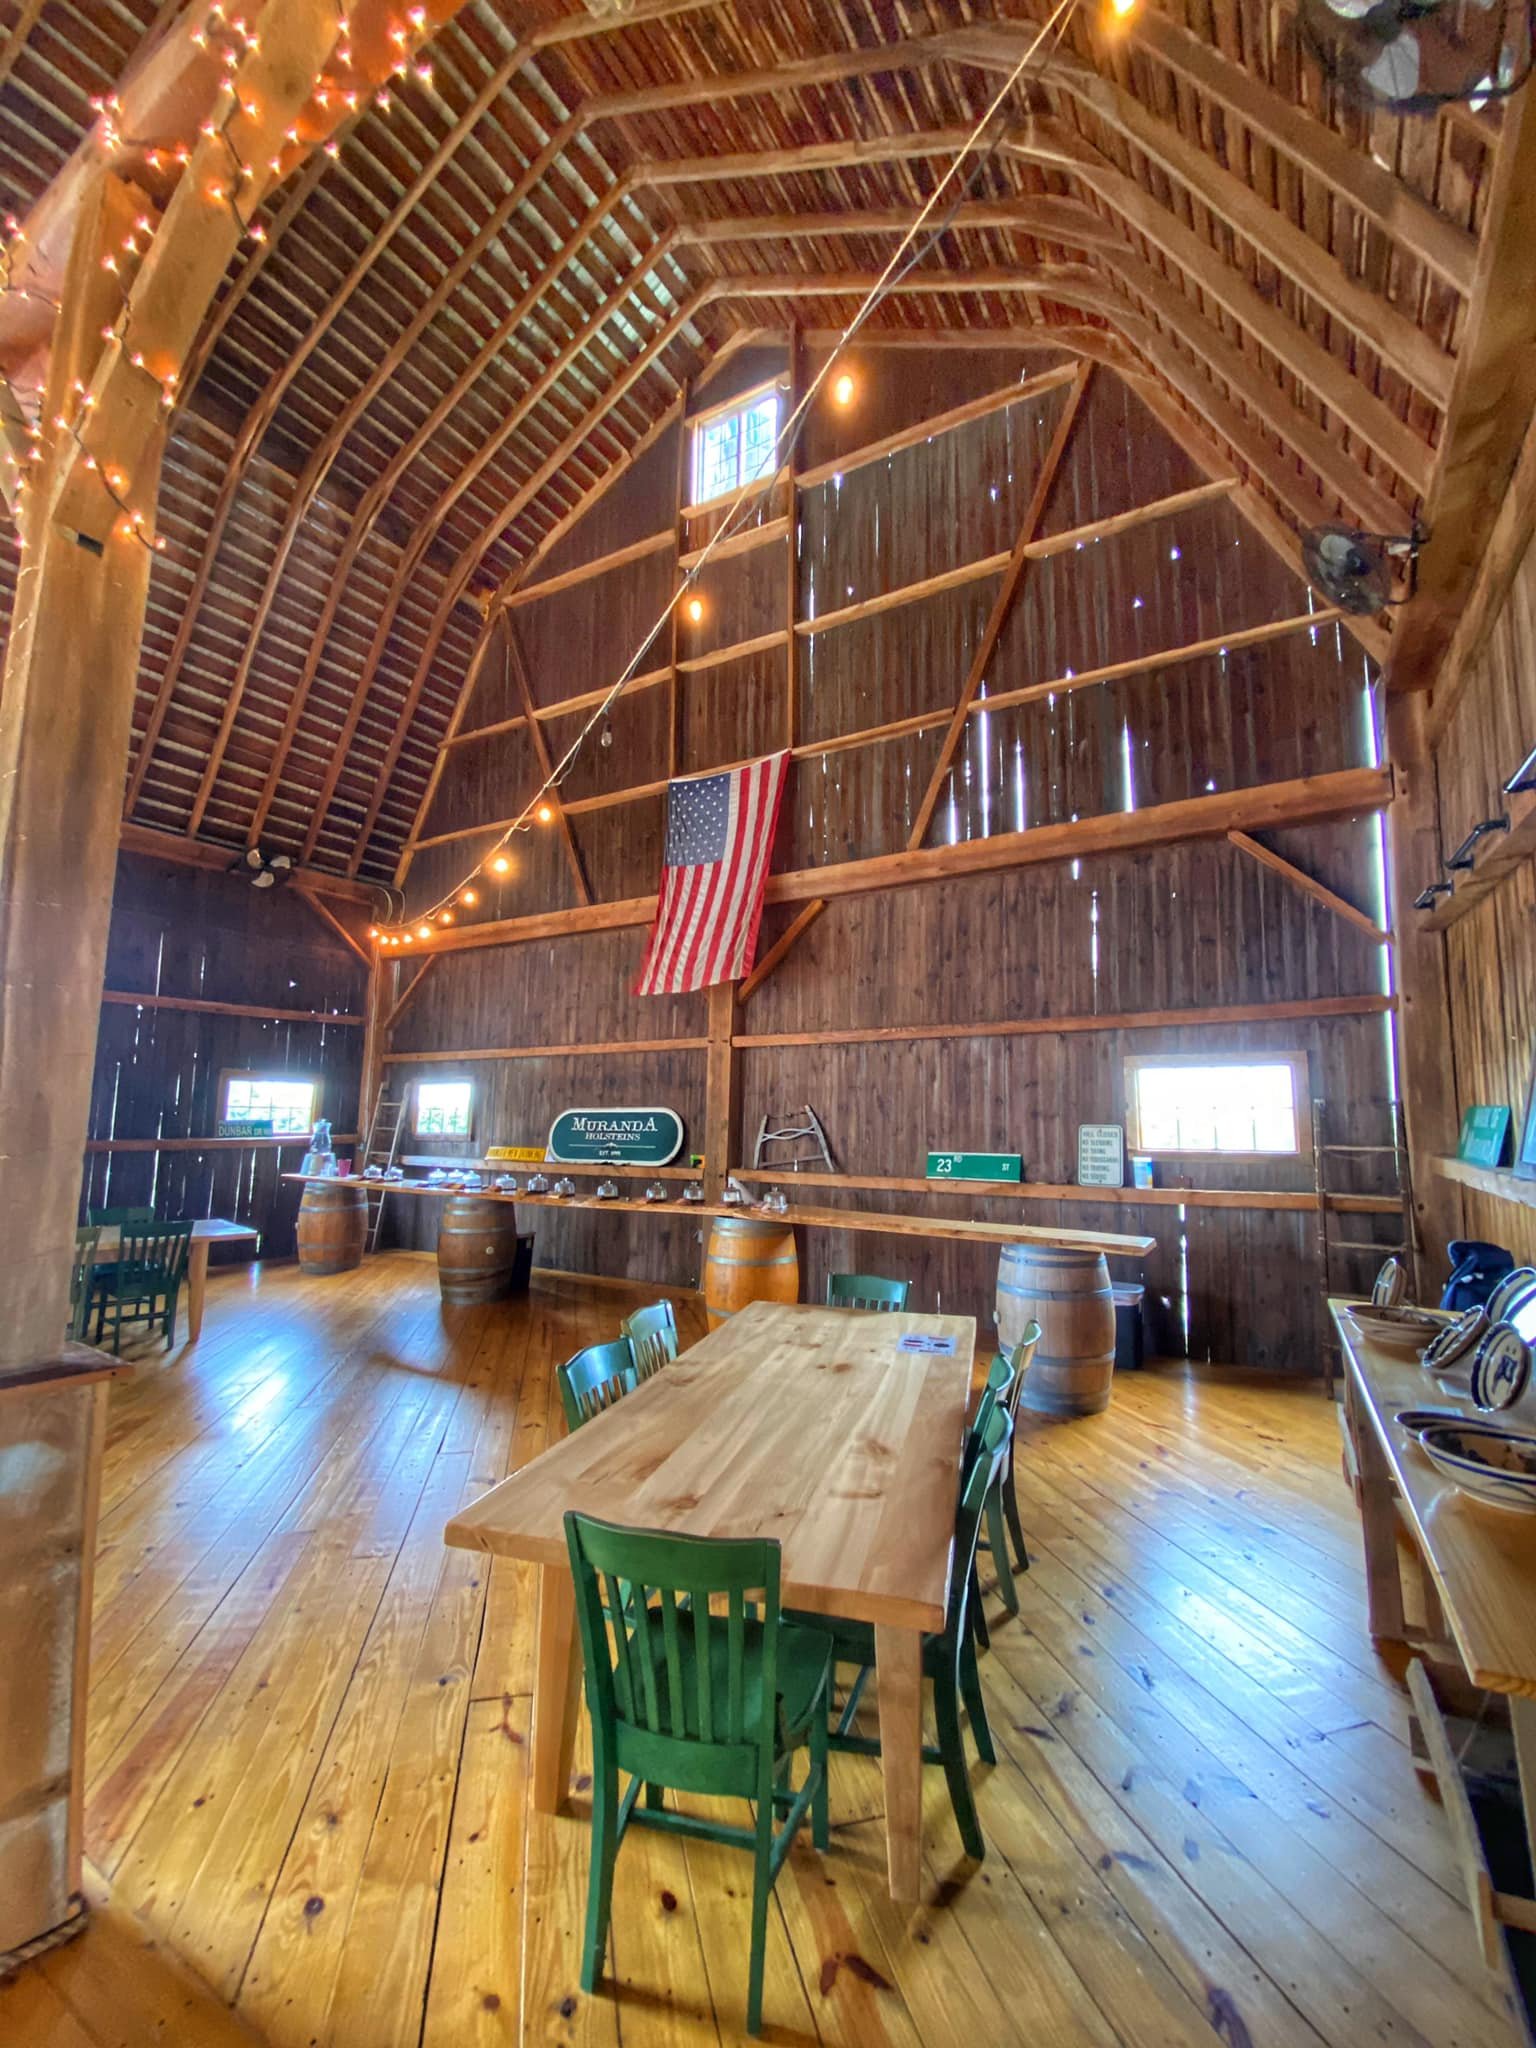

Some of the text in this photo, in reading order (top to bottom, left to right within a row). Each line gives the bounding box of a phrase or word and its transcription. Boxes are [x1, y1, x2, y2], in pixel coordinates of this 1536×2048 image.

[571, 1117, 658, 1131] MURANDA
[218, 1127, 252, 1136] DUNBAR
[585, 1132, 641, 1141] HOLSTEINS
[936, 1157, 952, 1173] 23
[1002, 1163, 1010, 1171] ST
